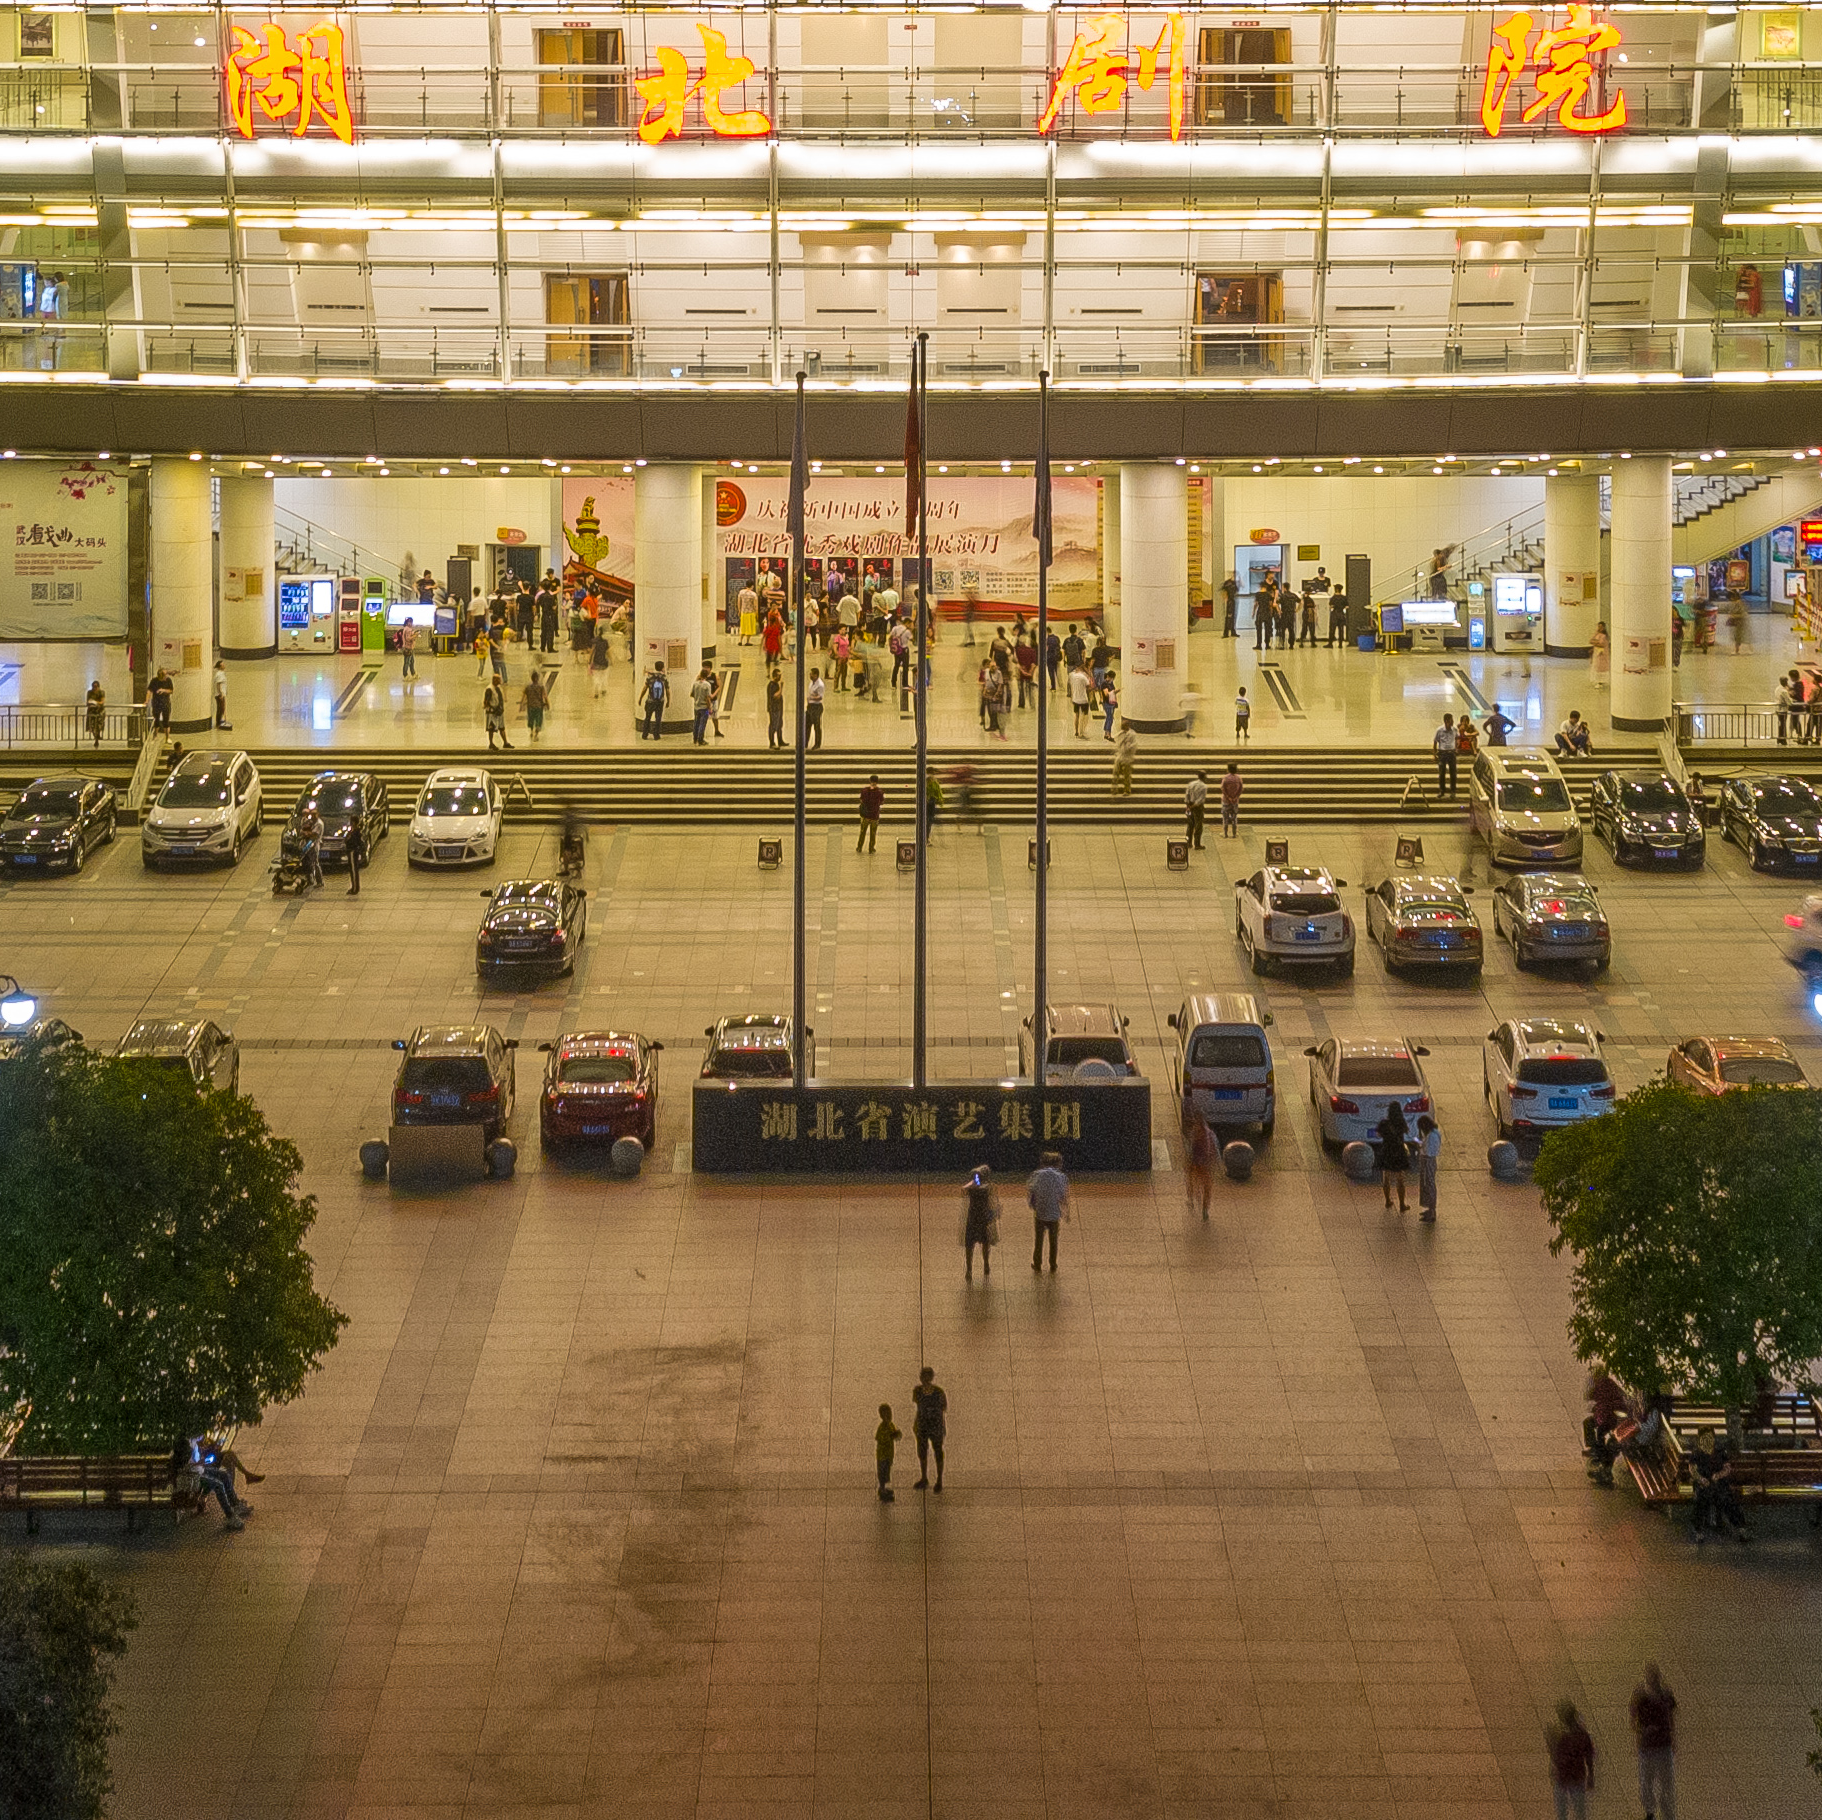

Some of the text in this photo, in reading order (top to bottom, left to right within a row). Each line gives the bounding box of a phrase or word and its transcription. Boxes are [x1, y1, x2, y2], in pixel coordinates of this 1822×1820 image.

[227, 4, 1628, 145] 湖北剧院
[760, 1100, 1082, 1141] 湖北省演艺集团
